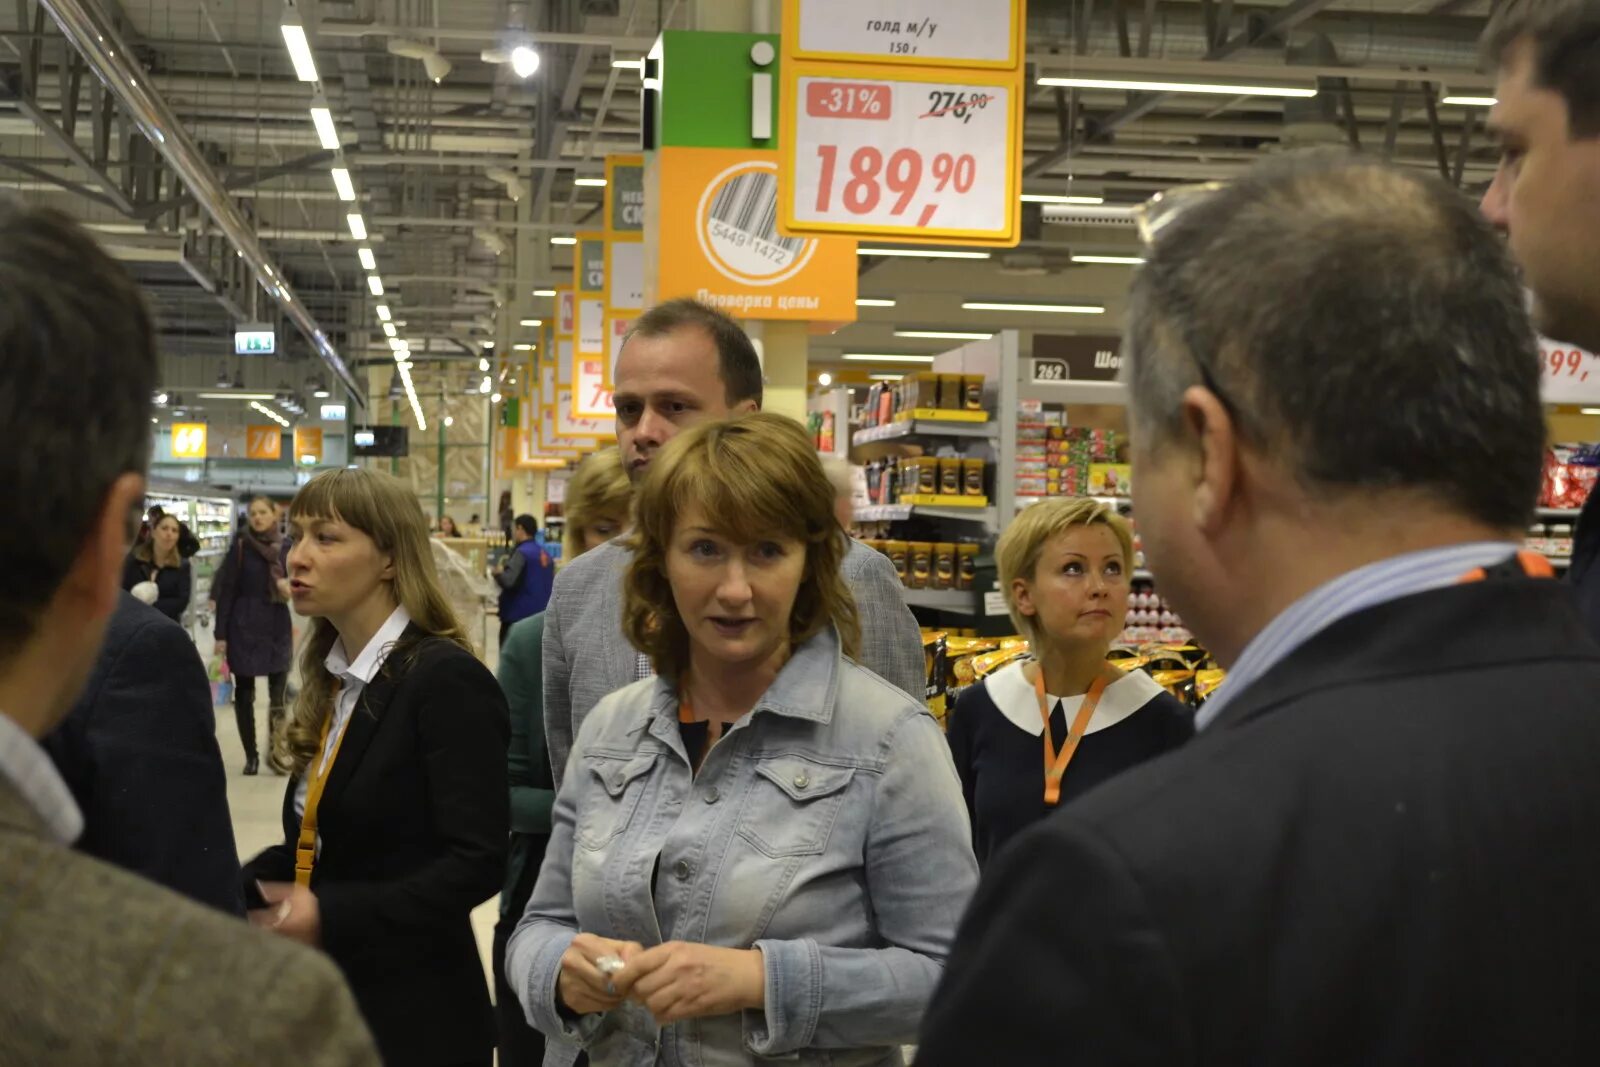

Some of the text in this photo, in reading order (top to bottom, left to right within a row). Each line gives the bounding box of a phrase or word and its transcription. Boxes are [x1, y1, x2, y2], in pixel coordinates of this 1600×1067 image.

[866, 19, 901, 35] голд
[889, 42, 910, 54] 150
[820, 87, 882, 115] -31%
[711, 223, 787, 266] 5449 1472
[777, 294, 820, 311] цены
[1037, 364, 1063, 379] 262
[251, 431, 277, 453] 70
